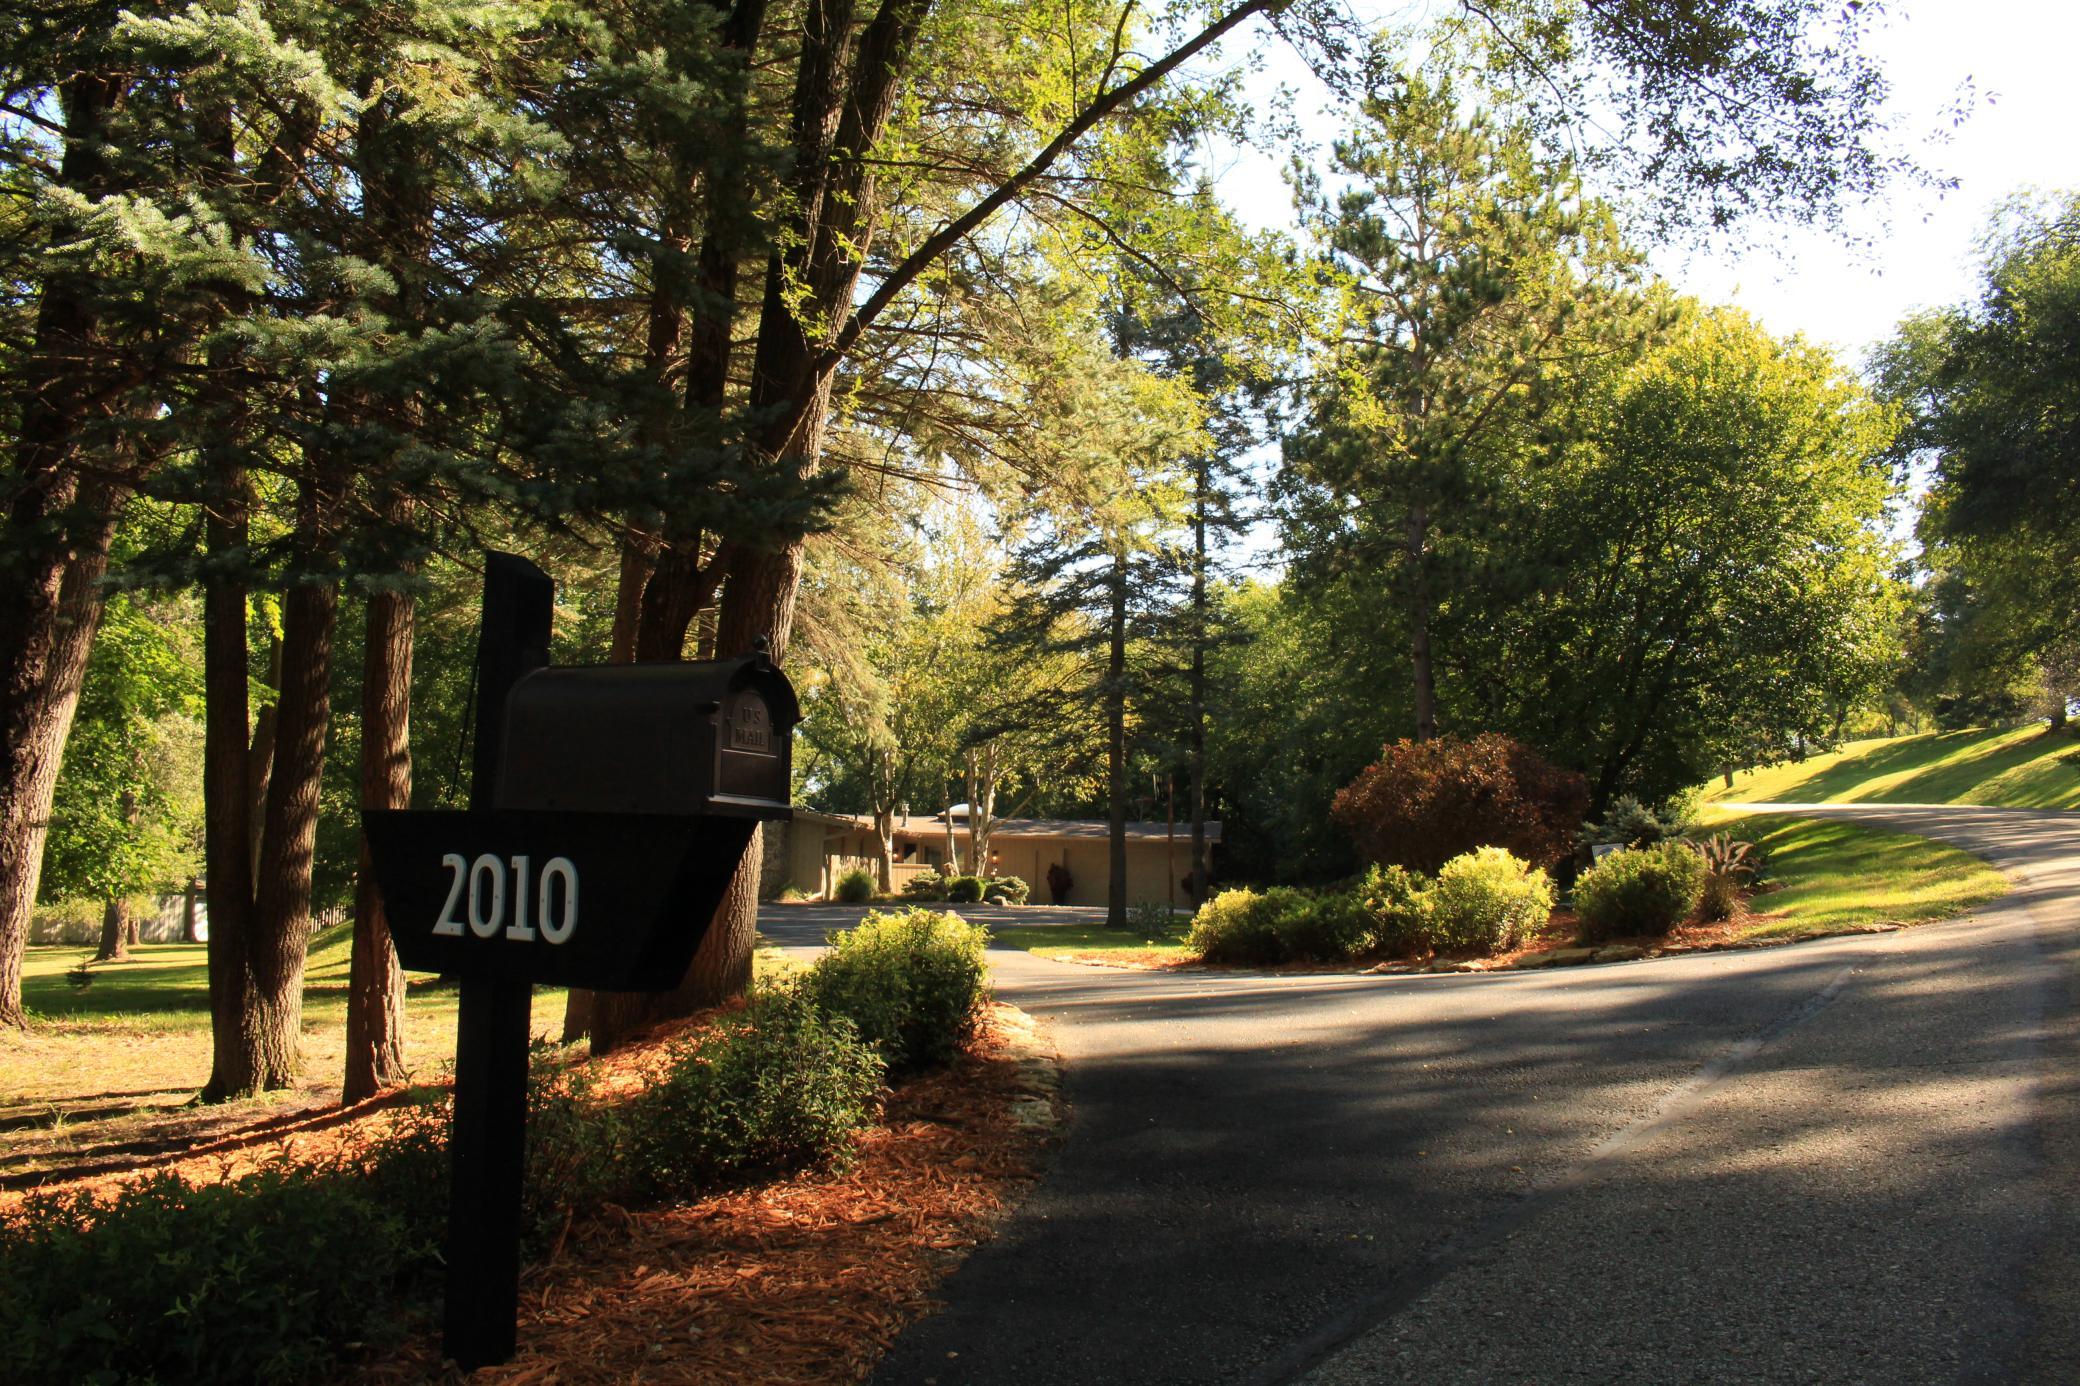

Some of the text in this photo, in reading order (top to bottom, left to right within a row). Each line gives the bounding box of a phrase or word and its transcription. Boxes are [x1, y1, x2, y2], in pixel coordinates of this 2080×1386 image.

[743, 706, 761, 725] US
[735, 728, 765, 746] MAIL
[432, 853, 579, 945] 2010
